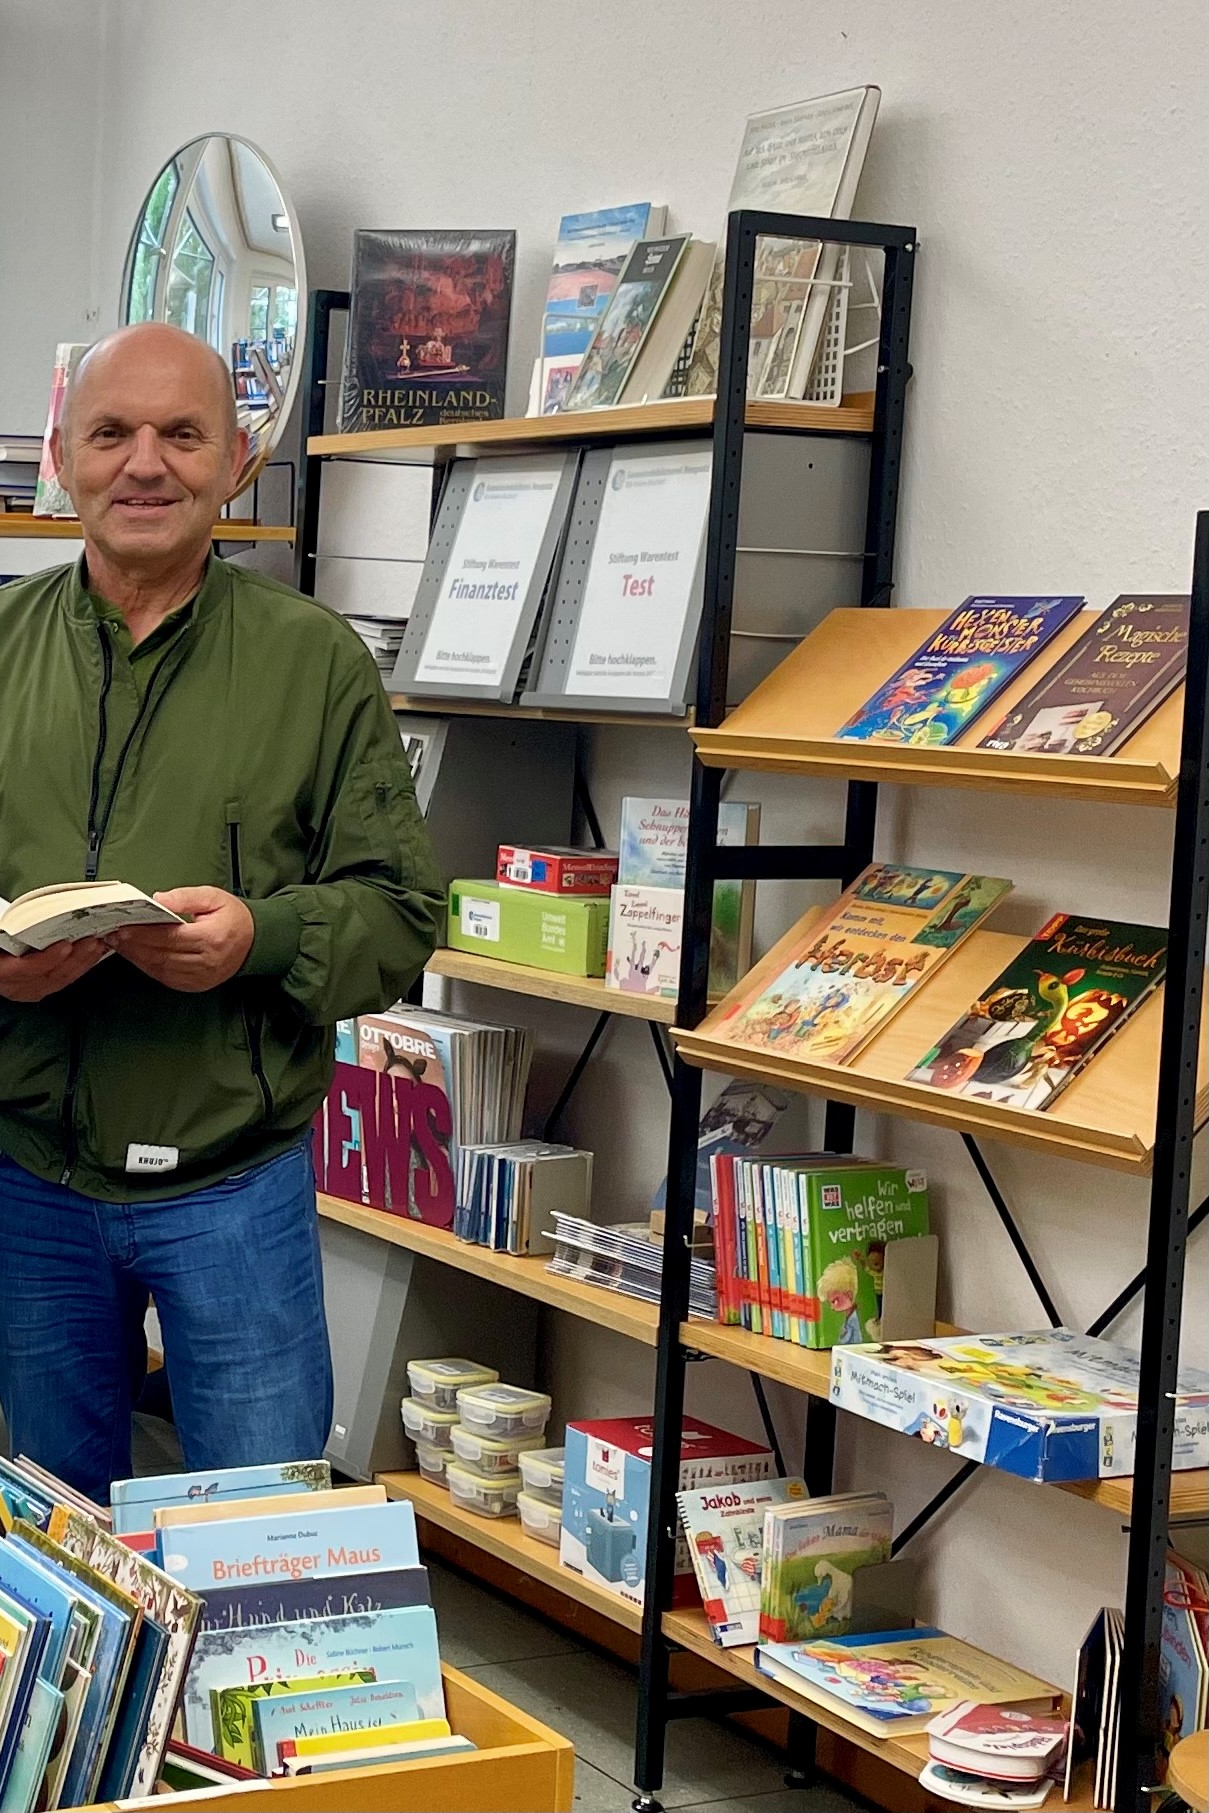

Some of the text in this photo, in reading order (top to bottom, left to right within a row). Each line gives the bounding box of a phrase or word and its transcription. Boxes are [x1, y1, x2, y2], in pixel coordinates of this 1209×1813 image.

[363, 389, 497, 407] RHEINLAND-
[360, 407, 424, 425] PFALZ
[608, 551, 680, 565] Stiftung Warentest
[448, 578, 519, 600] Finanztest
[622, 574, 655, 597] Test
[1102, 624, 1188, 648] Magische
[607, 654, 658, 667] hochklappen.
[1093, 645, 1161, 668] Rezepte
[652, 805, 671, 817] Das
[639, 834, 659, 845] und
[620, 903, 681, 924] Zappelfinger
[845, 927, 888, 939] entdecken
[795, 934, 930, 985] Herbst
[1047, 932, 1168, 969] Kürbisbuch
[360, 1024, 437, 1059] OTTOBRE
[313, 1062, 454, 1231] EWS
[877, 1180, 899, 1197] Wir
[845, 1196, 911, 1221] helfen und
[828, 1218, 904, 1244] vertragen
[850, 1371, 917, 1405] Mitmach-Spiel
[995, 1408, 1041, 1434] Ravensburger
[700, 1492, 741, 1511] Jakob
[267, 1530, 318, 1542] Marianne Dubuc
[822, 1524, 859, 1539] Mama
[212, 1547, 381, 1580] Briefträger Maus
[228, 1602, 285, 1627] Hund
[295, 1595, 333, 1620] und
[295, 1648, 317, 1667] Die
[294, 1715, 383, 1738] Mein Haus ist
